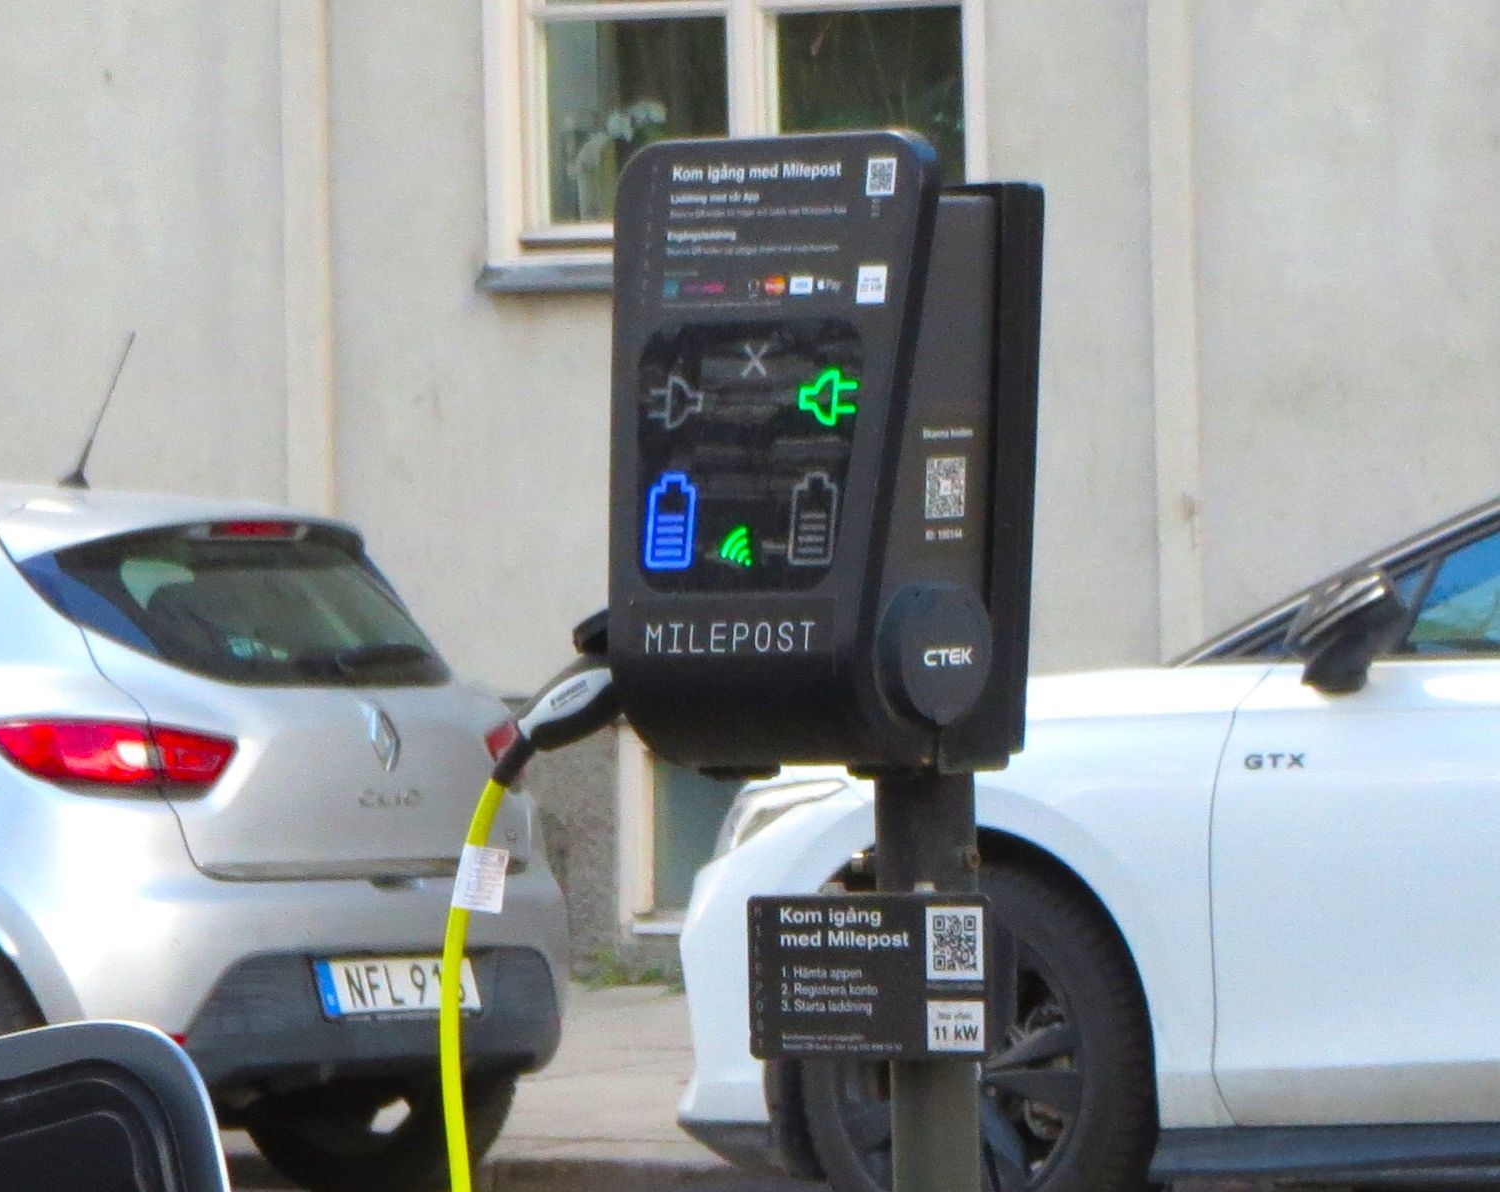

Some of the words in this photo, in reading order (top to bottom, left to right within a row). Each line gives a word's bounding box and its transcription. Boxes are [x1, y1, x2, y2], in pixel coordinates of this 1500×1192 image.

[672, 165, 703, 181] Kom
[708, 163, 745, 183] igång
[749, 164, 778, 179] med
[783, 161, 842, 181] Milepost
[645, 621, 815, 653] MILEPOST
[923, 647, 973, 667] CTEK
[1244, 753, 1305, 770] GTX
[780, 907, 822, 924] Kom
[828, 907, 881, 927] igång
[780, 930, 822, 947] med
[828, 930, 909, 950] Milepost
[344, 964, 405, 1008] NFL
[410, 962, 466, 1005] 91
[849, 984, 879, 996] konto
[933, 1026, 947, 1040] 11
[954, 1024, 978, 1041] kW
